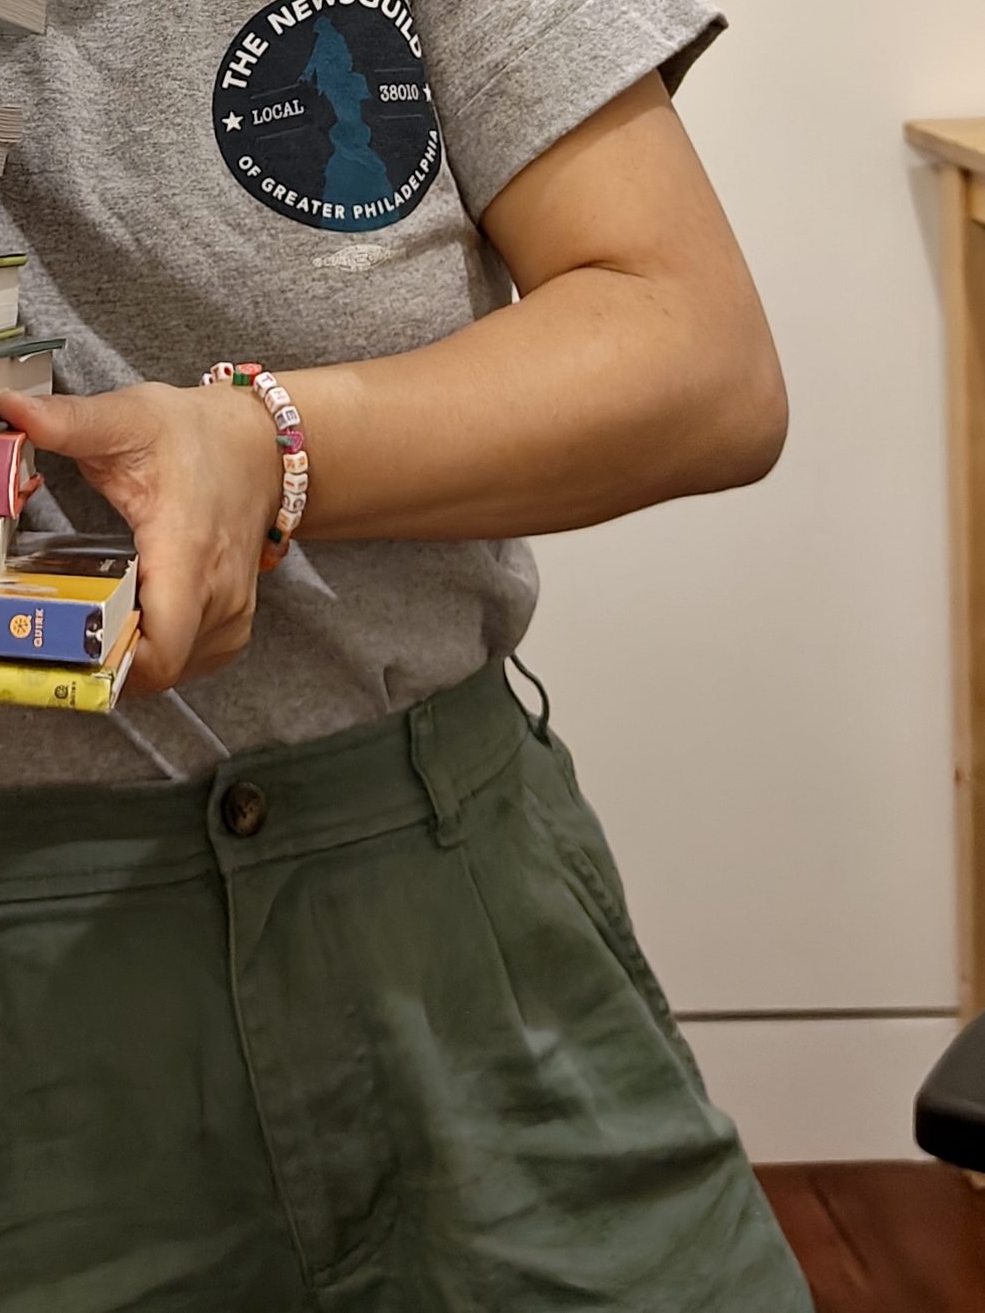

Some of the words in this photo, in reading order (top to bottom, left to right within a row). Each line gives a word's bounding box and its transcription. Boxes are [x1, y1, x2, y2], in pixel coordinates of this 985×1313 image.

[222, 32, 269, 90] THE
[251, 99, 305, 125] LOCAL
[379, 85, 419, 102] 38010
[238, 155, 262, 178] OF
[261, 177, 345, 219] GREATER
[353, 129, 438, 219] PHILADELPHIA
[32, 608, 45, 647] QUIRK
